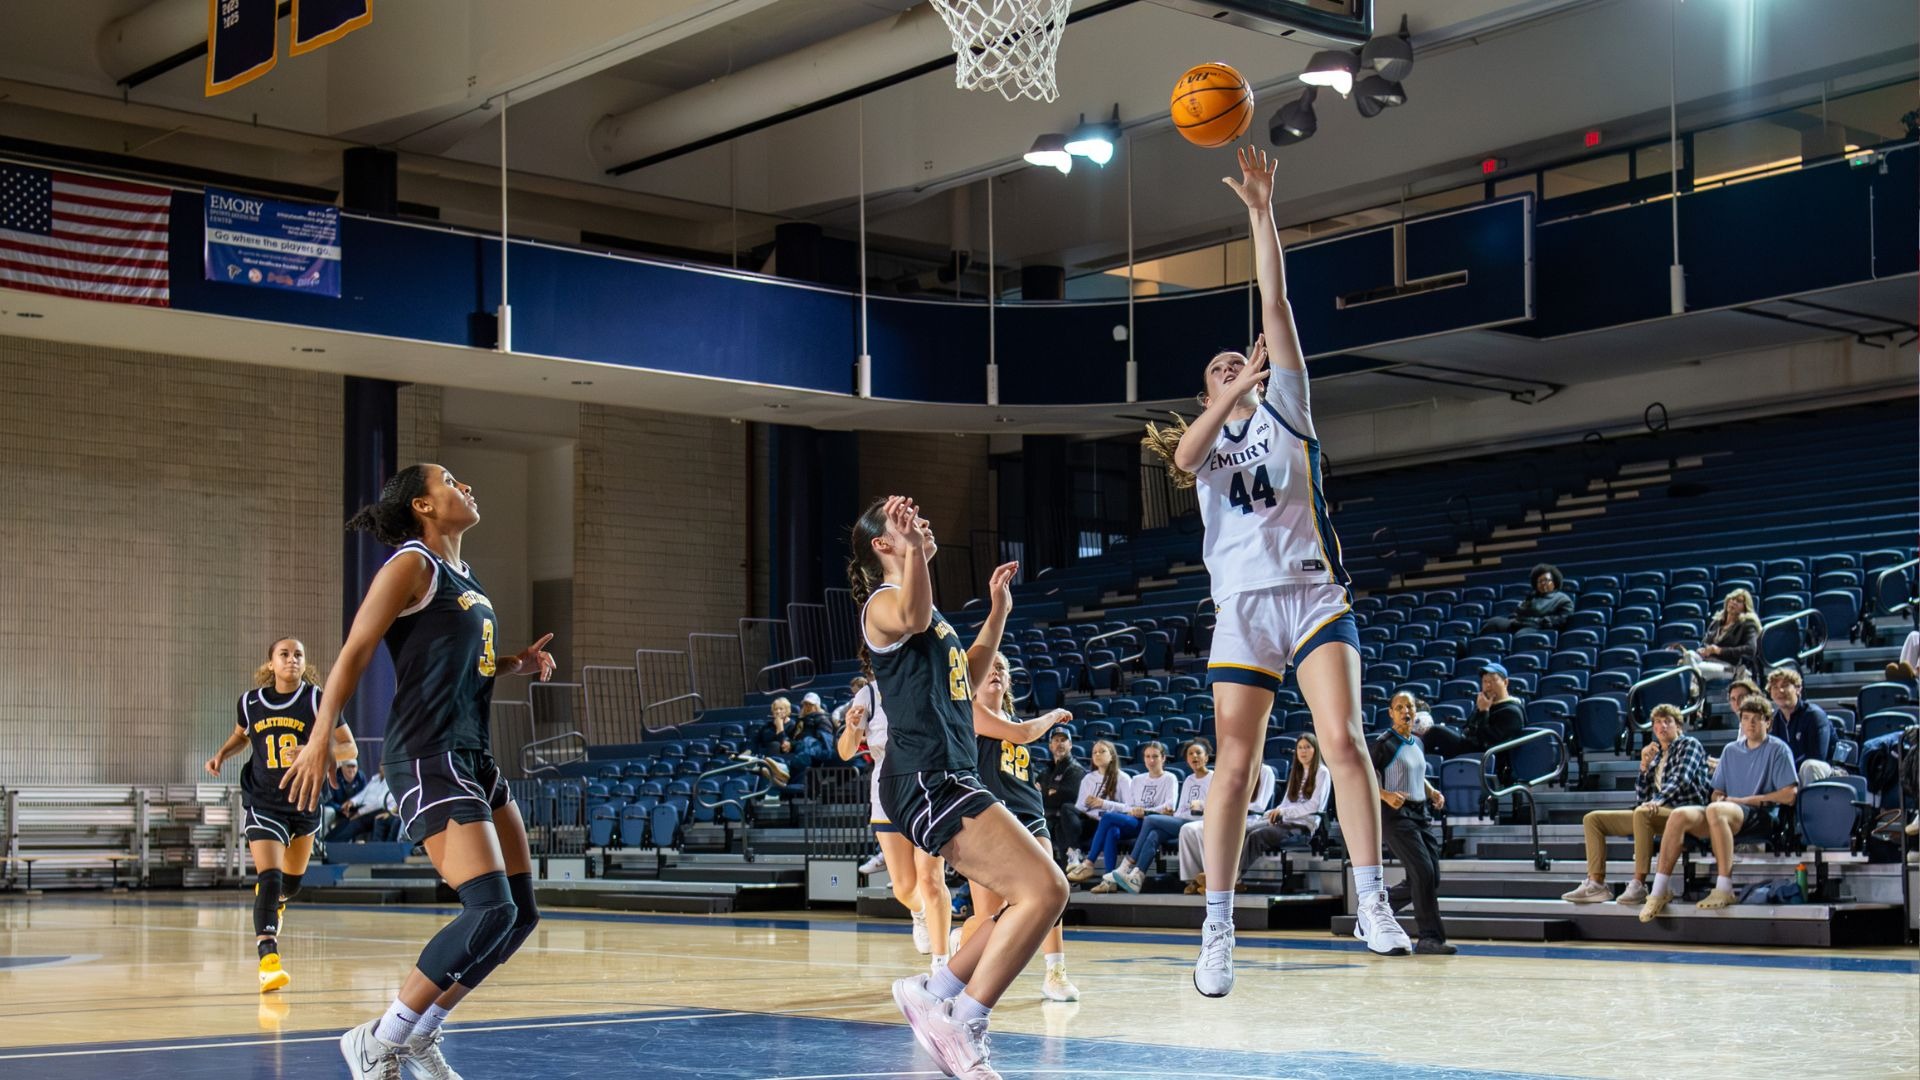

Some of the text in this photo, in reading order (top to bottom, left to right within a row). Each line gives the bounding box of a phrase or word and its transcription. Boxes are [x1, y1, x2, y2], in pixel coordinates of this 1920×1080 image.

[210, 194, 264, 216] EMORY
[214, 230, 229, 241] Go
[232, 234, 261, 245] where
[263, 238, 278, 248] the
[280, 241, 314, 256] players
[1210, 438, 1270, 472] EMORY
[1229, 463, 1278, 515] 44
[478, 618, 497, 678] 3
[265, 733, 298, 769] 12
[1000, 739, 1031, 782] 22
